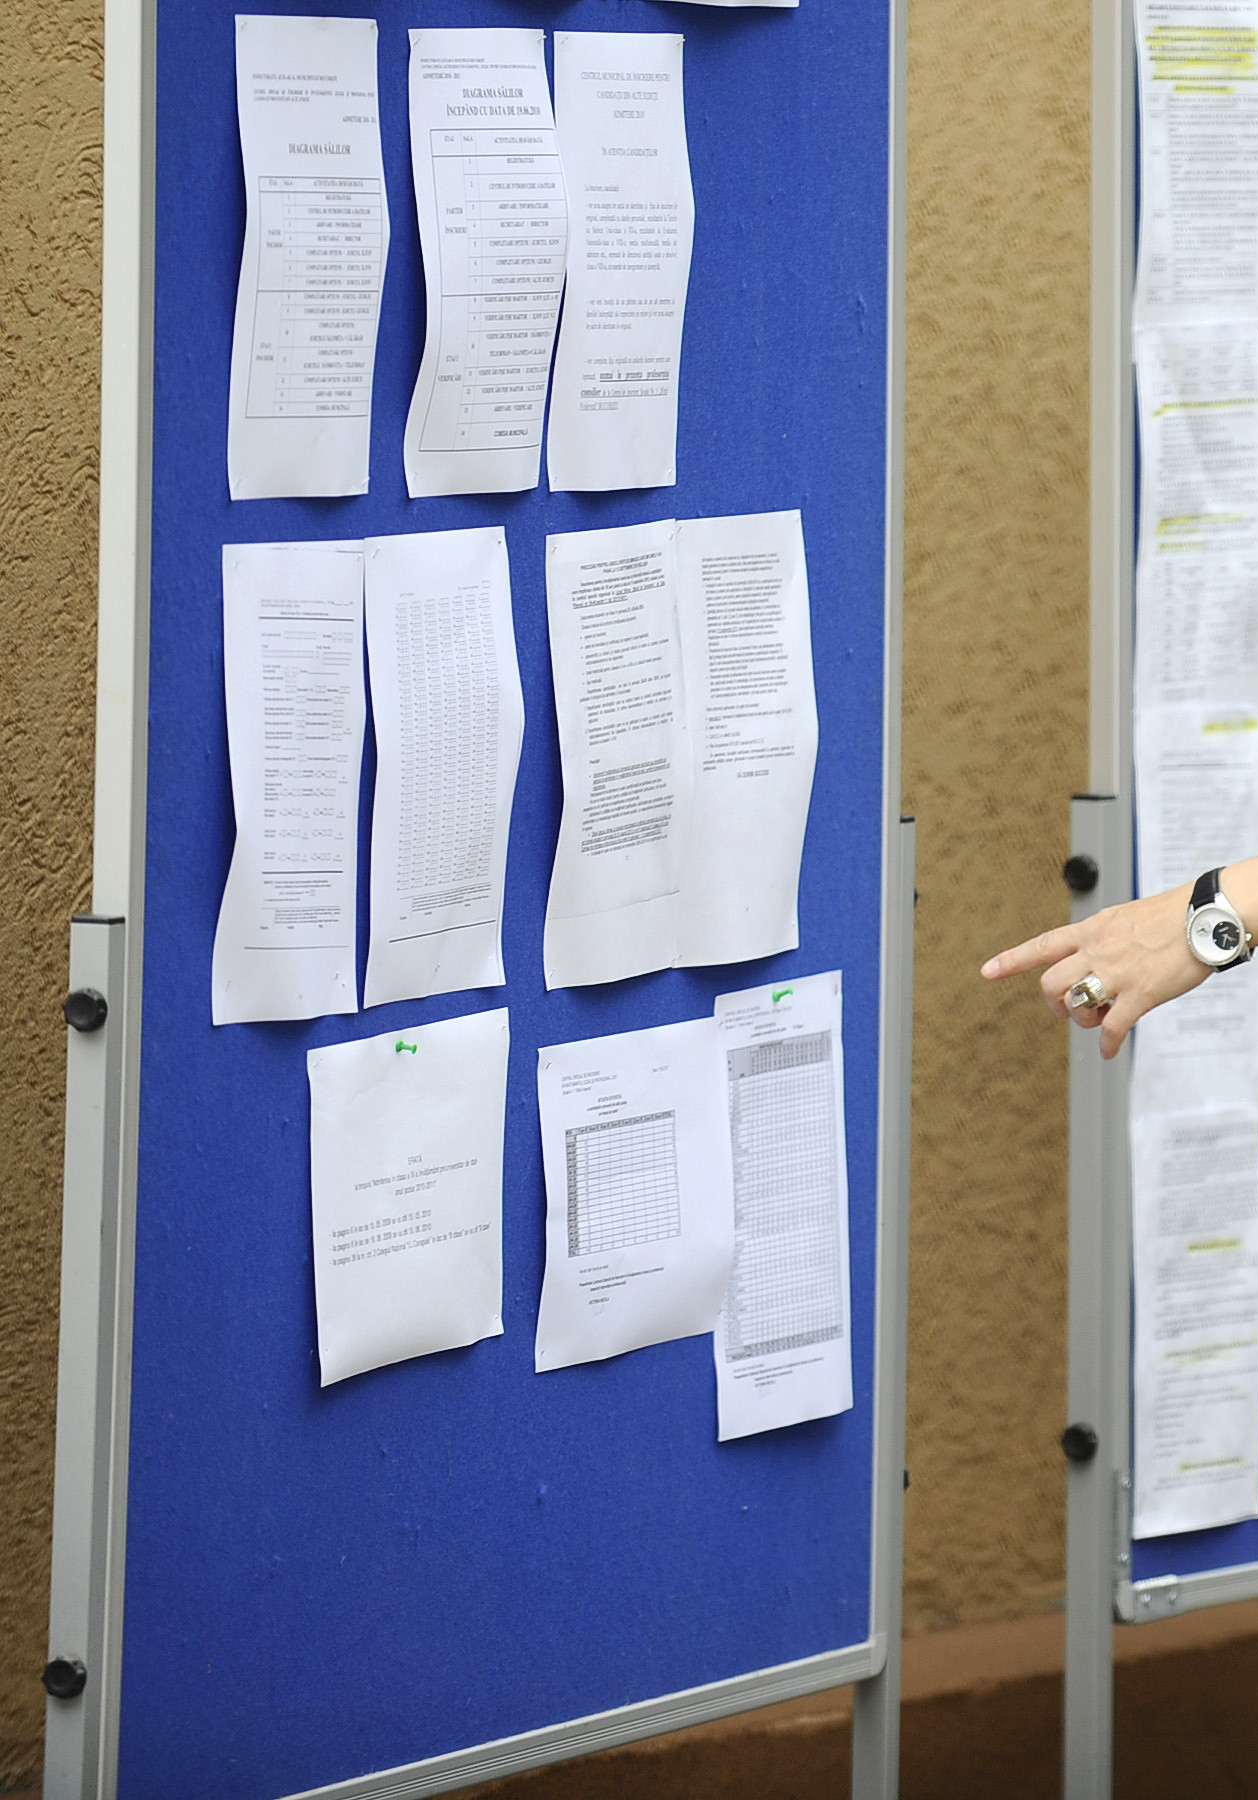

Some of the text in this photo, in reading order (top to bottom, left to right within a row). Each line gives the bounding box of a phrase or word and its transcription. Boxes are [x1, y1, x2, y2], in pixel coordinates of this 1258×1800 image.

[462, 88, 497, 99] DIAGRAMA
[446, 102, 478, 117] ÎNCEPÂND
[479, 105, 489, 116] CU
[489, 105, 507, 116] DATA
[507, 105, 516, 116] DE
[288, 142, 322, 156] DIAGRAMA
